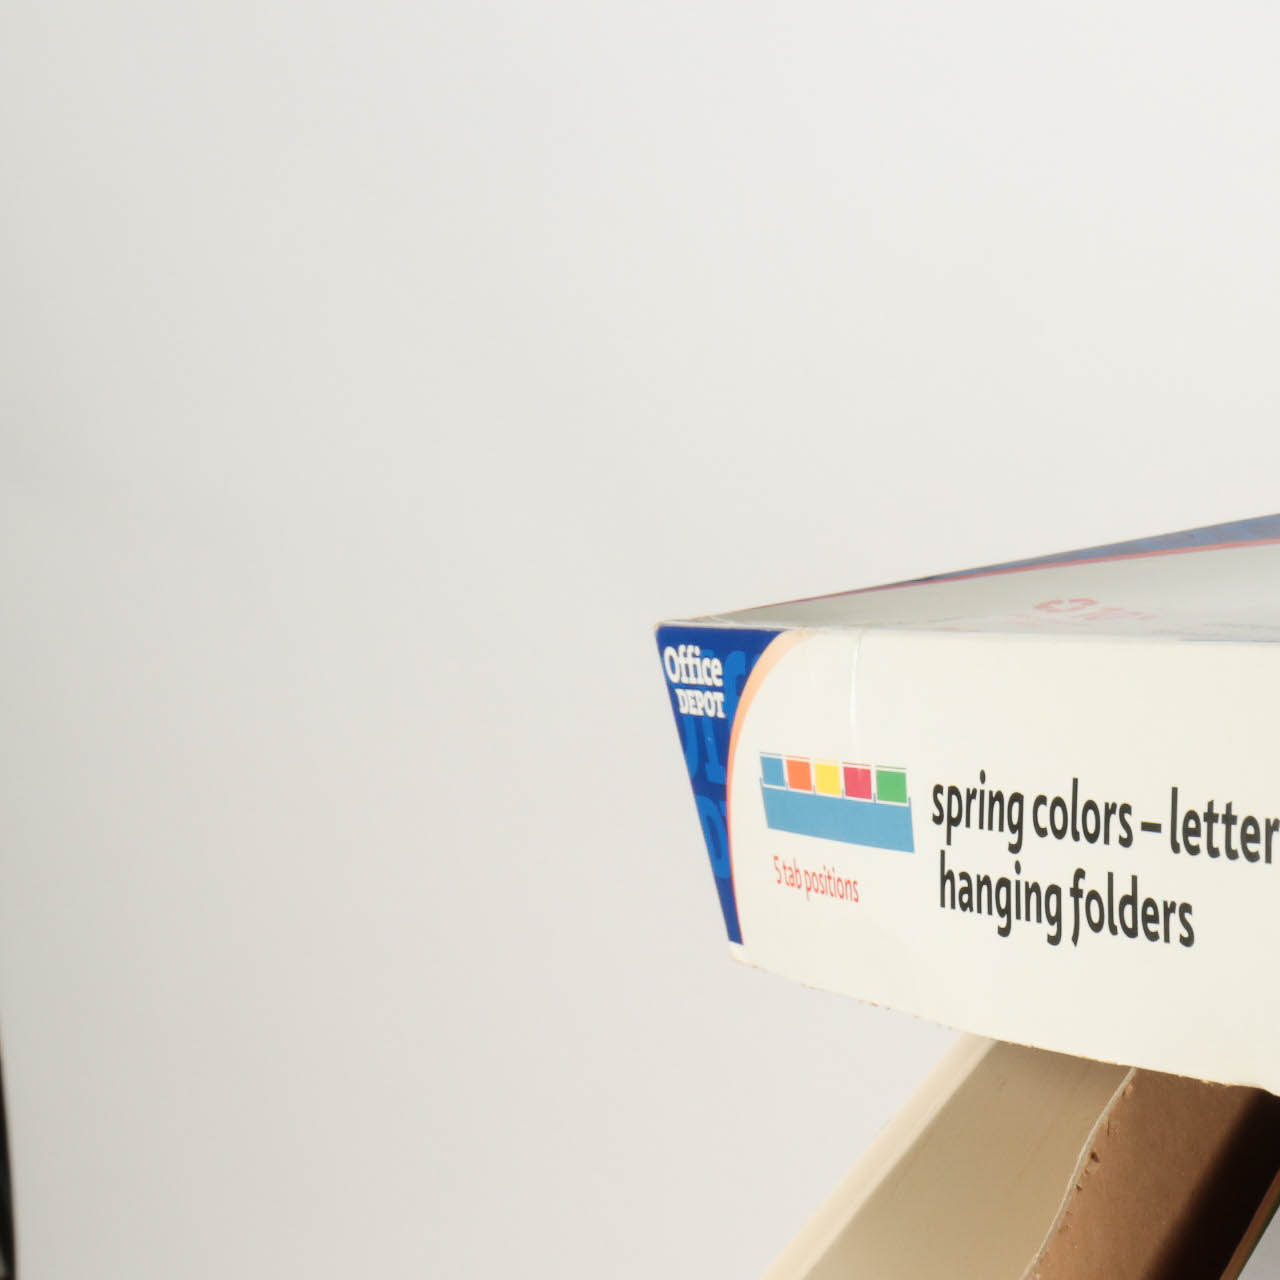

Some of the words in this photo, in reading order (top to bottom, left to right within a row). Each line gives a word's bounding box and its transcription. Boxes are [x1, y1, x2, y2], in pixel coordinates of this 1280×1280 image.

[663, 645, 724, 687] Office
[676, 688, 726, 719] DEPOT
[932, 769, 1024, 855] spring
[773, 855, 782, 884] 5
[782, 861, 801, 890] tab
[803, 865, 859, 903] positions
[940, 850, 1061, 946] hanging
[1070, 867, 1195, 948] folders
